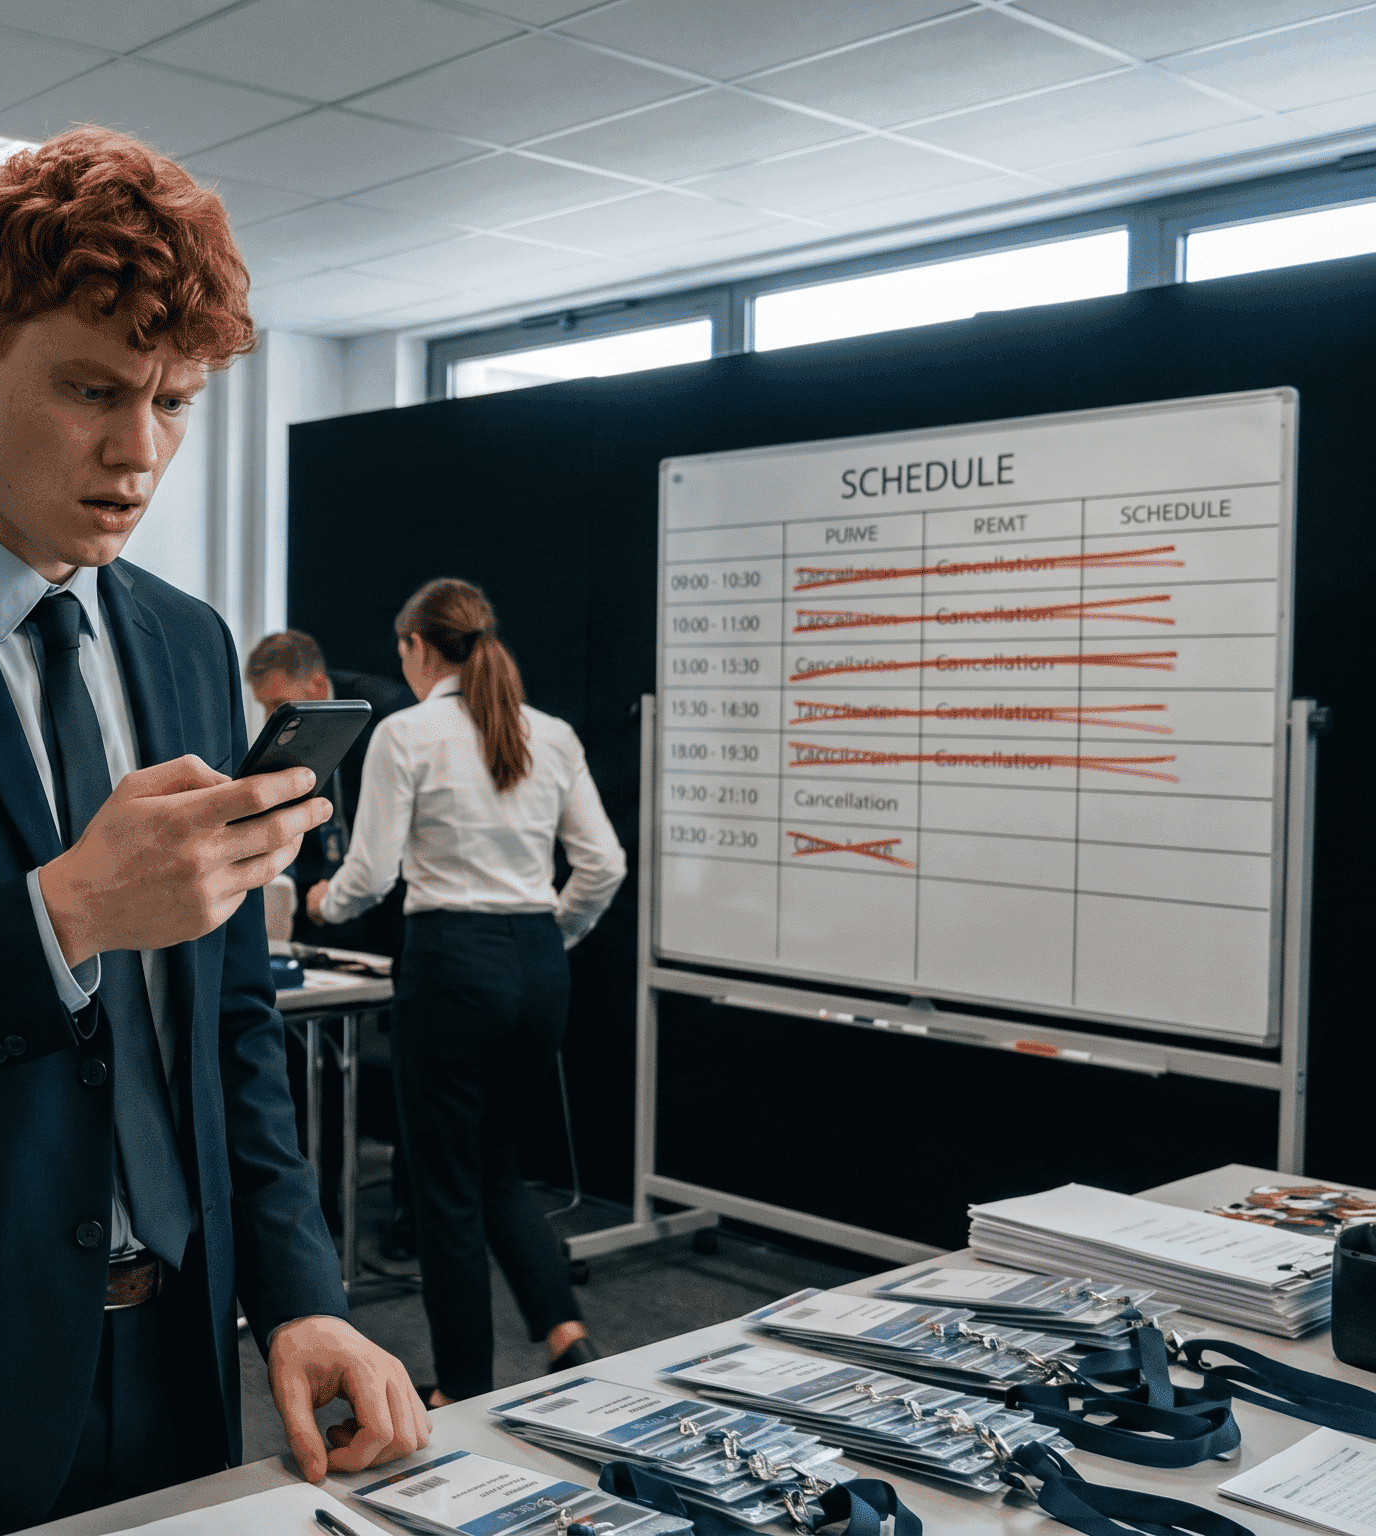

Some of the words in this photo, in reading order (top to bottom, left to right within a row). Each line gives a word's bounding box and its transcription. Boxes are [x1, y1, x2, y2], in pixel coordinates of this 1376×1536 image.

[841, 453, 1014, 499] SCHEDULE
[1120, 499, 1231, 525] SCHEDULE
[722, 570, 761, 588] 10:30
[797, 564, 897, 586] ancellati
[722, 614, 760, 632] 11:00
[935, 653, 1055, 674] Cancellation
[718, 786, 759, 804] 21:10
[794, 789, 898, 812] Cancellation
